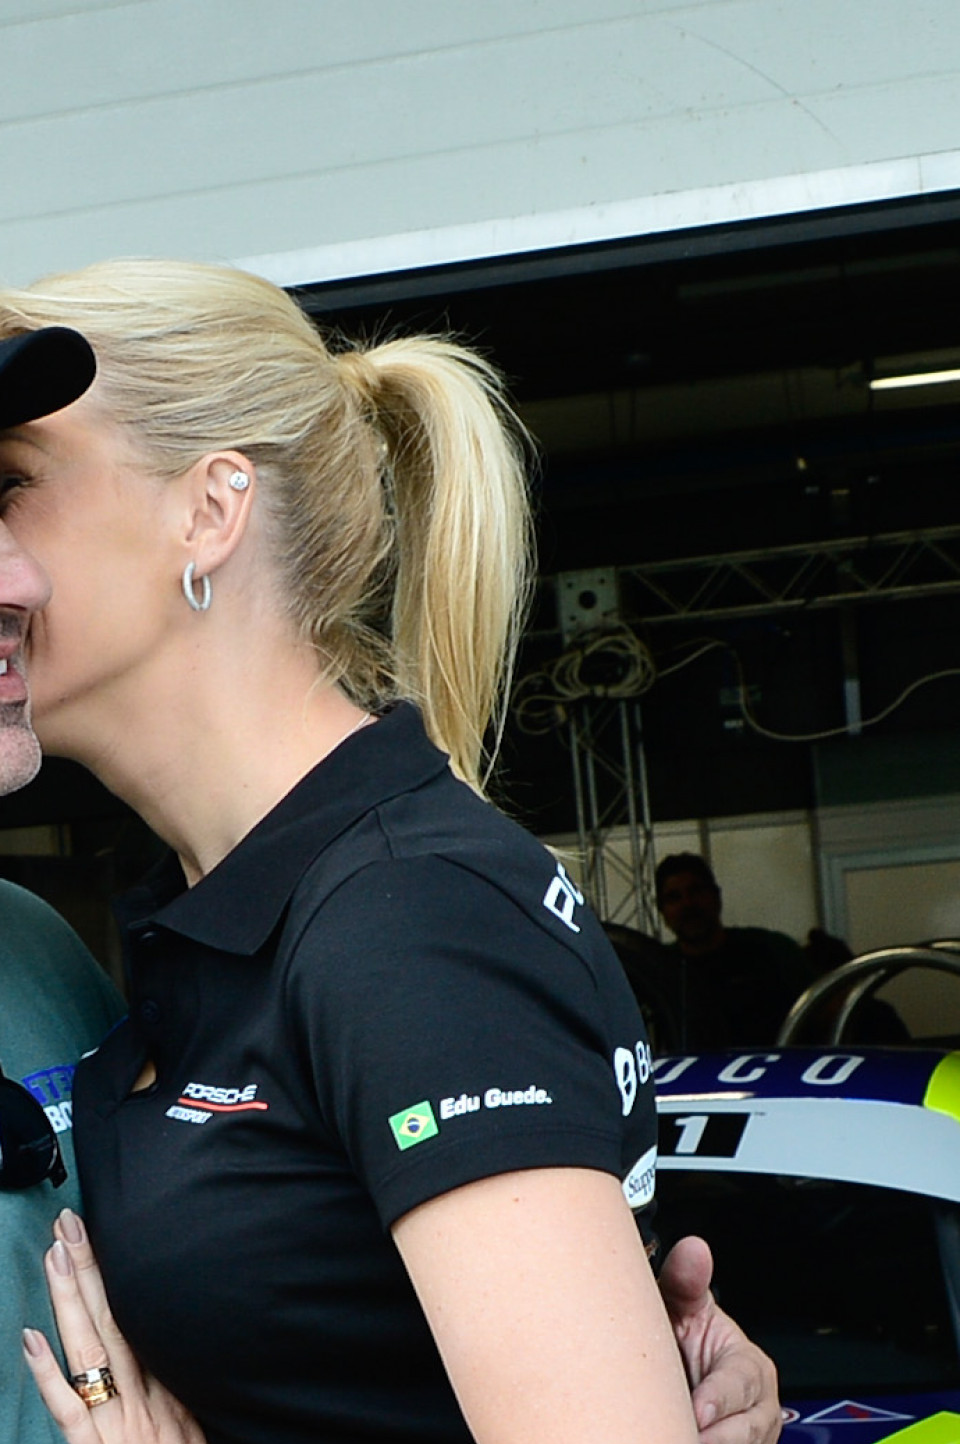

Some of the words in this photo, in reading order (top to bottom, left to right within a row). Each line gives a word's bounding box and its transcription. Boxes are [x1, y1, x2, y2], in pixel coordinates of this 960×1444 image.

[181, 1081, 258, 1104] PORSCHE
[439, 1093, 481, 1120] Edu
[674, 1115, 709, 1155] 1
